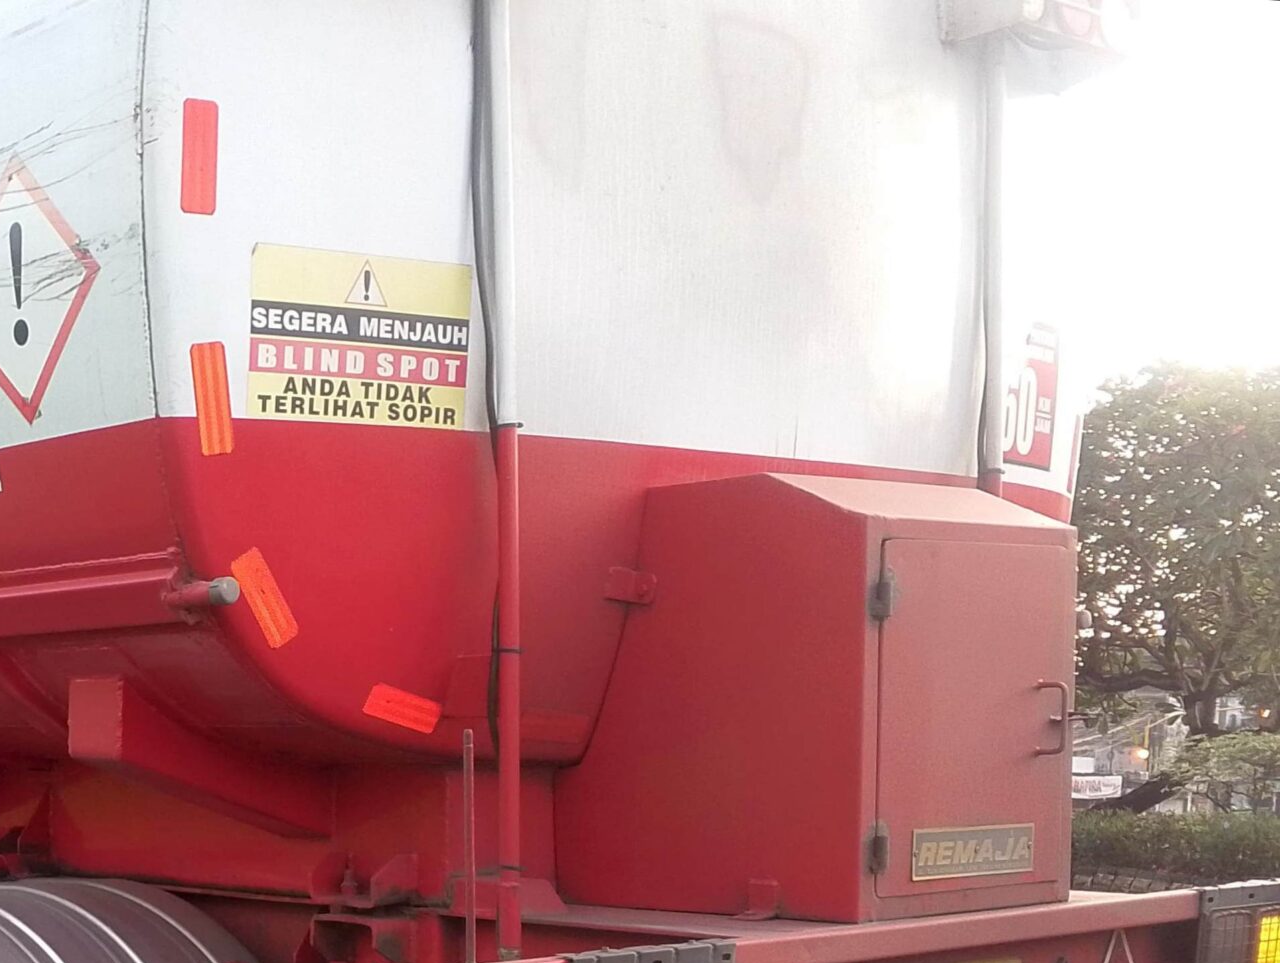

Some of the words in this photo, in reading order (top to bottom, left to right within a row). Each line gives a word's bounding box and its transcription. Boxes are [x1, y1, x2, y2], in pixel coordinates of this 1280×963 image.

[251, 306, 349, 336] SEGERA
[359, 316, 468, 346] MENJAUH
[257, 343, 365, 375] BLIND
[376, 352, 461, 383] SPOT
[283, 376, 351, 399] ANDA
[361, 381, 432, 405] TIDAK
[257, 394, 380, 420] TERLIHAT
[387, 402, 457, 426] SOPIR
[918, 837, 1030, 866] REMAJA
